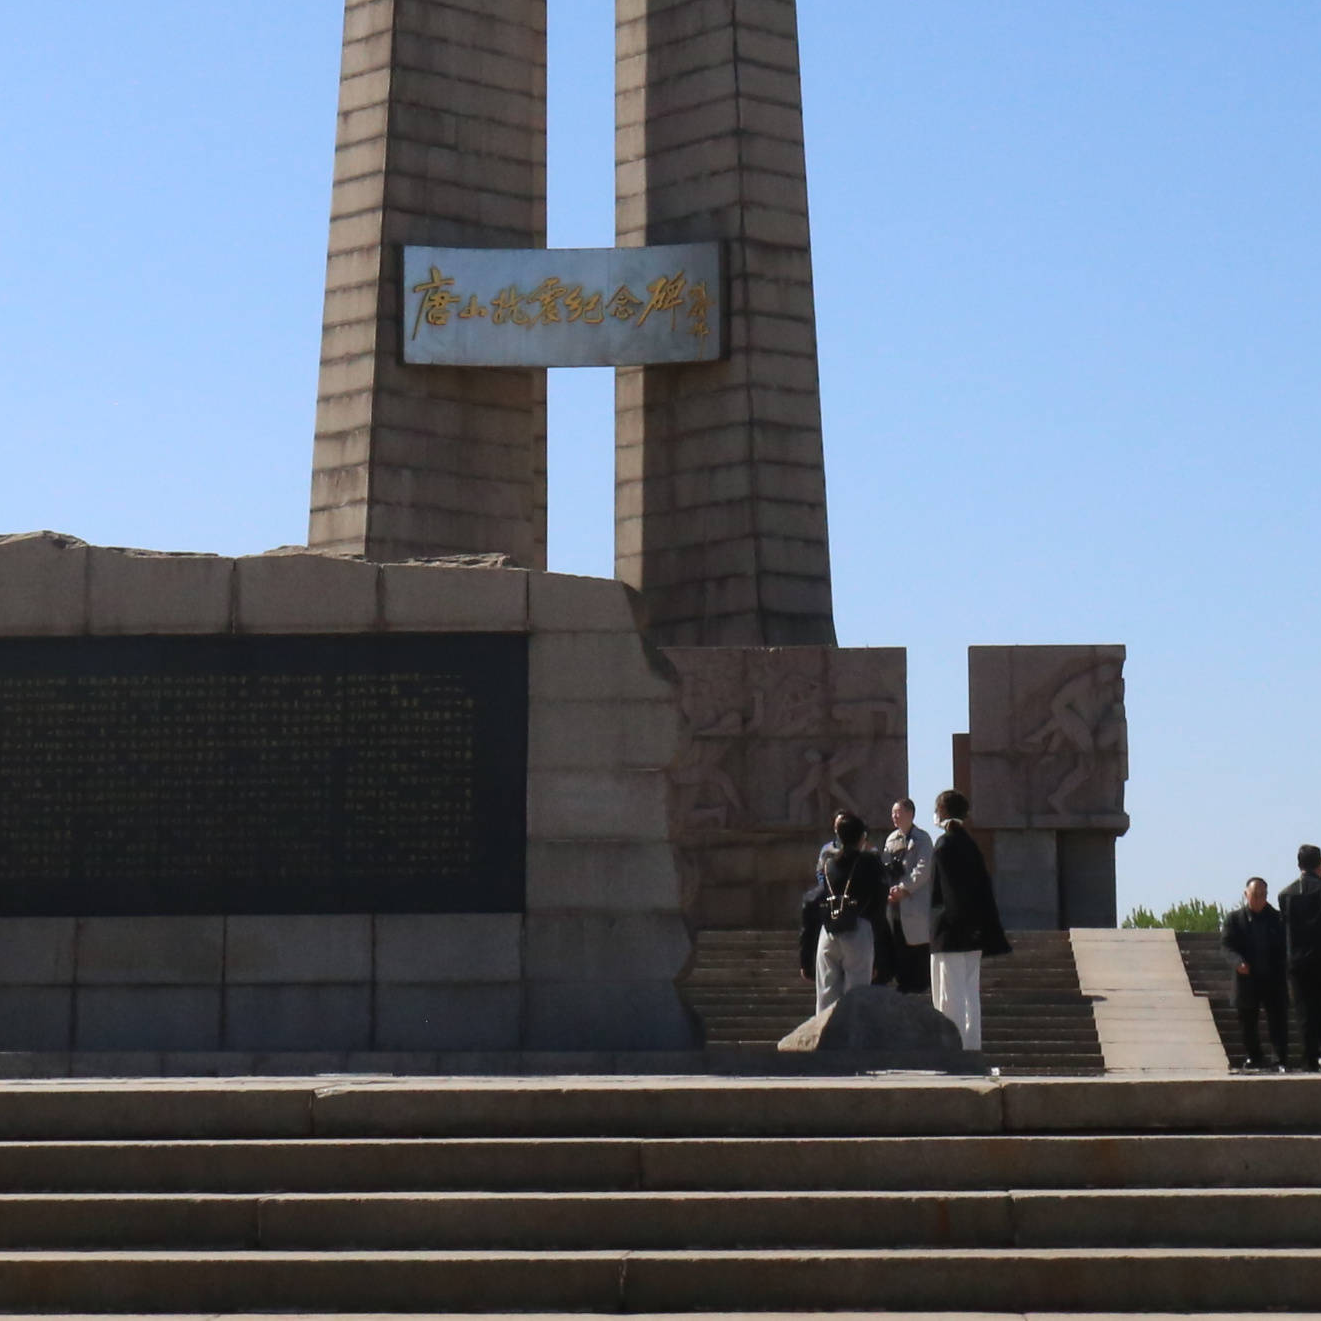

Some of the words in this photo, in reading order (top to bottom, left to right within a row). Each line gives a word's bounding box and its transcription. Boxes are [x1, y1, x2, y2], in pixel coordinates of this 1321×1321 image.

[412, 266, 688, 341] 唐山抗震纪念碑
